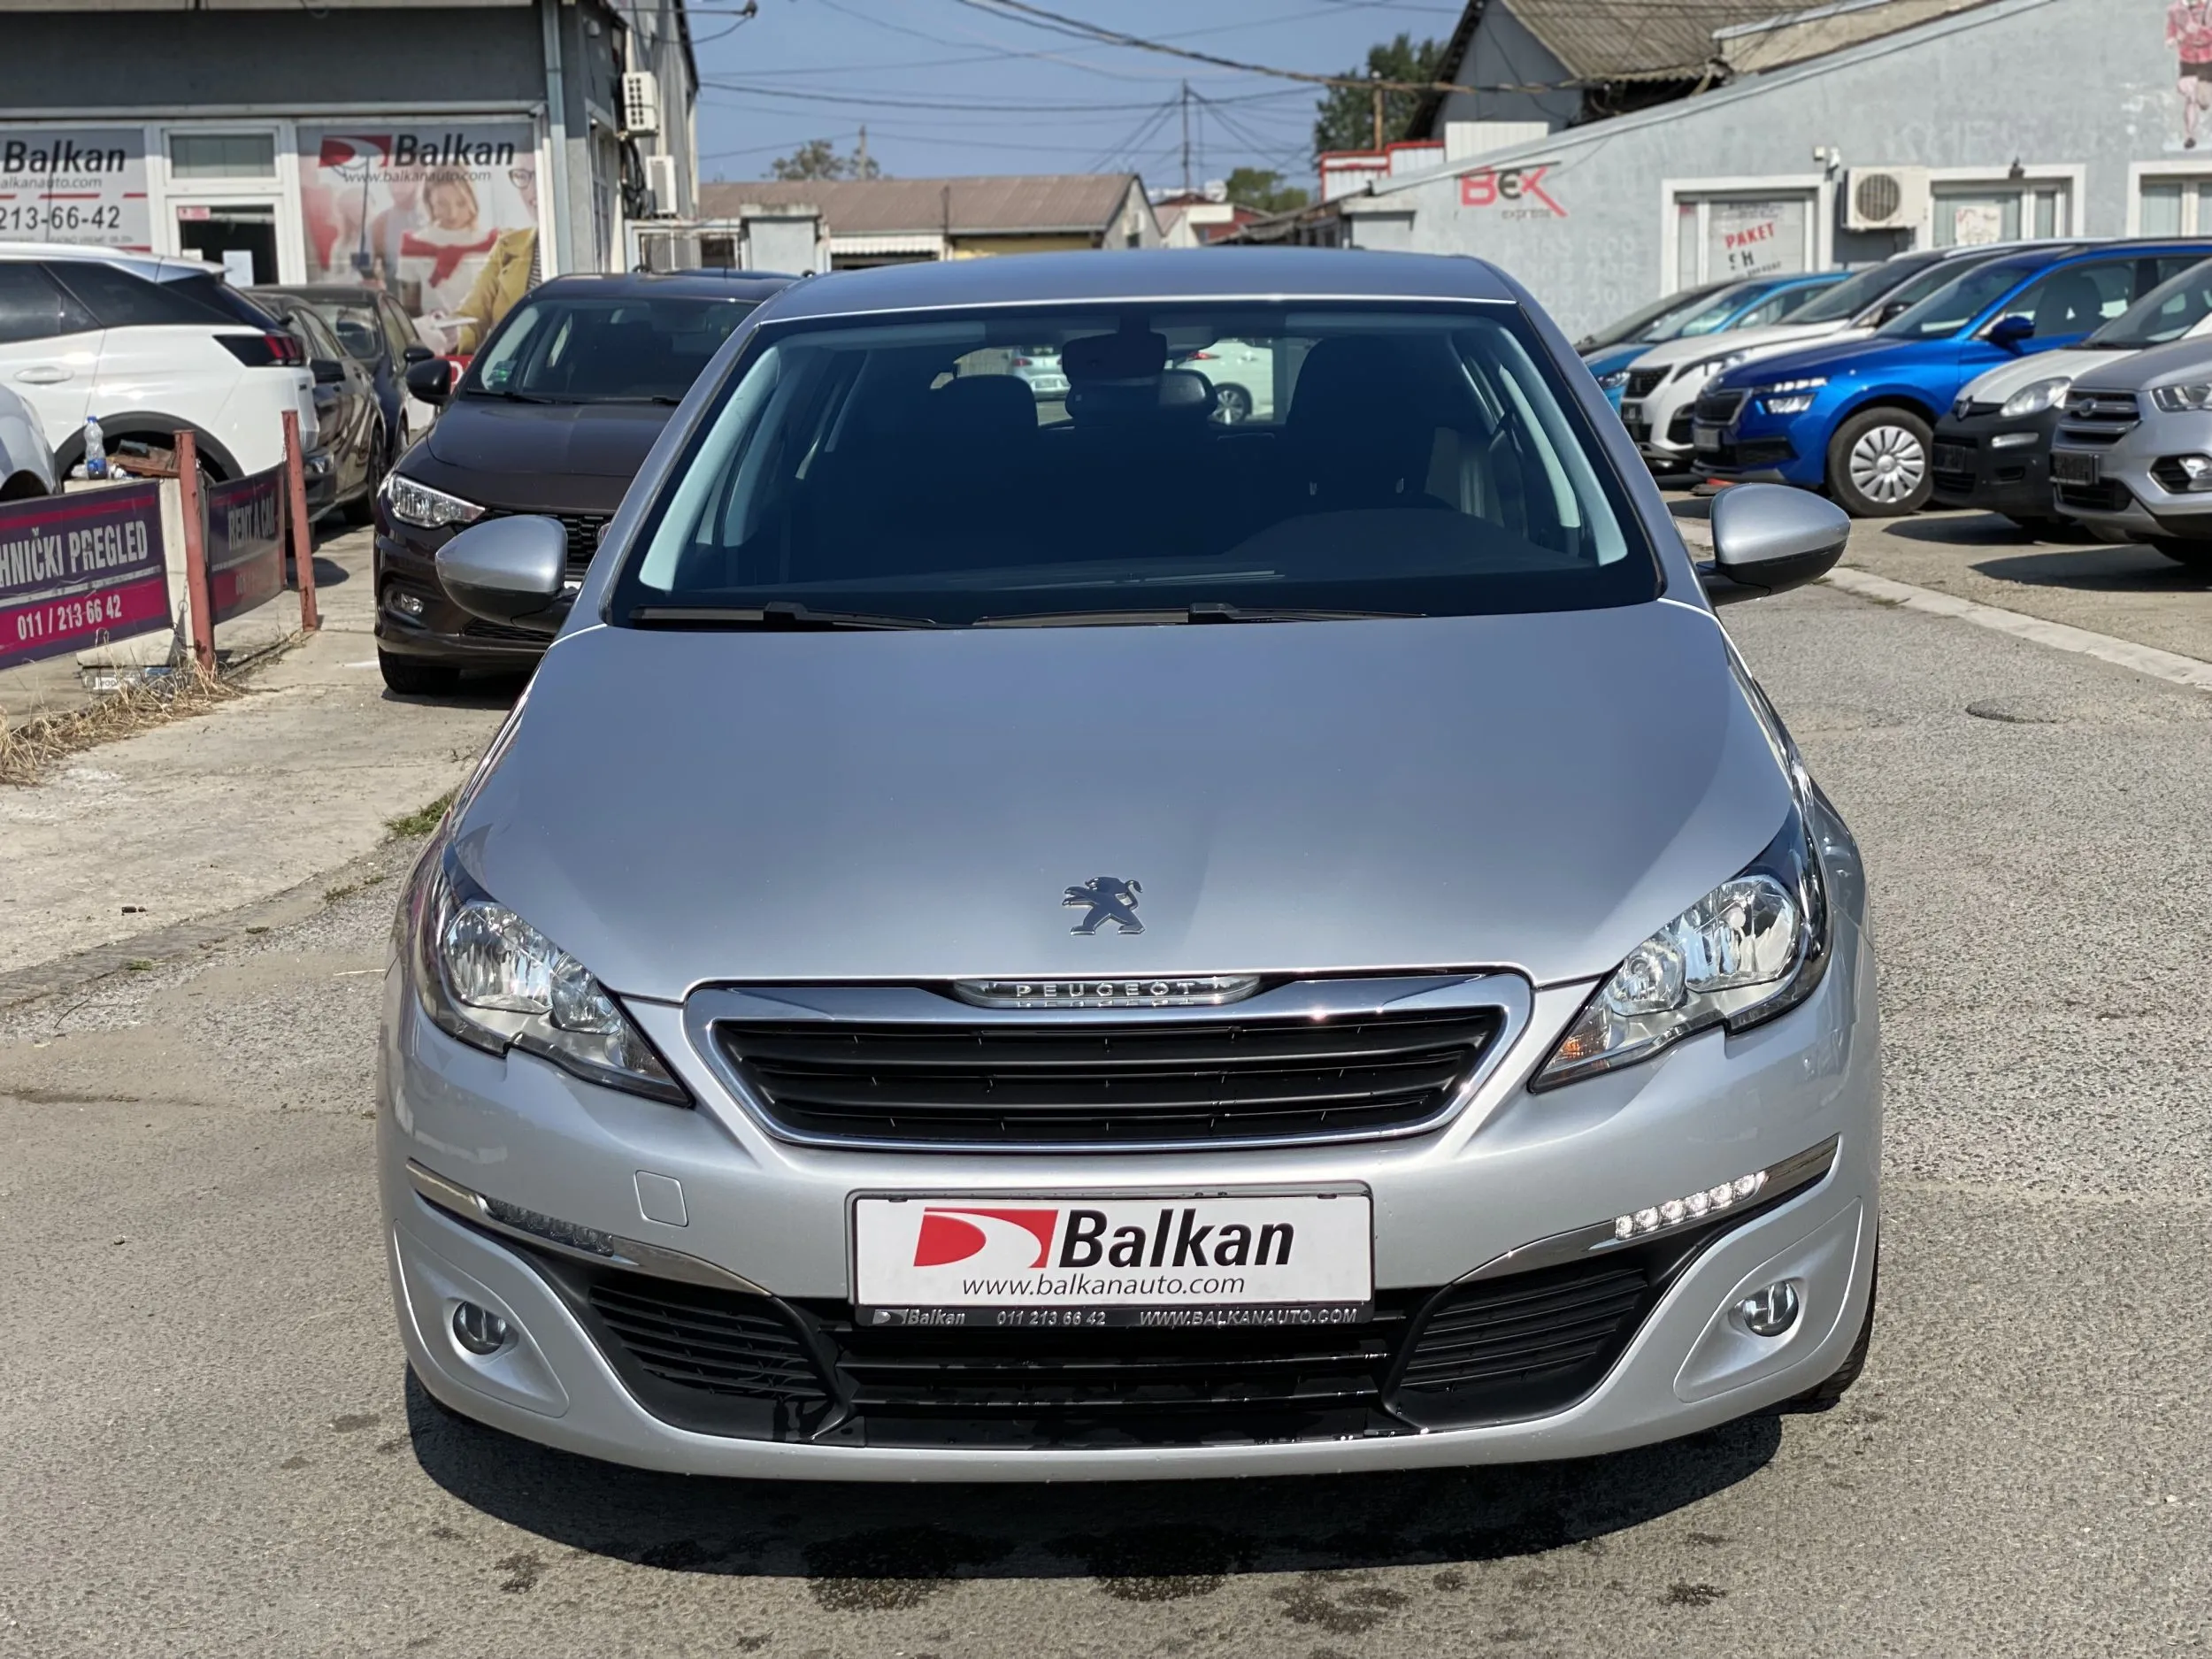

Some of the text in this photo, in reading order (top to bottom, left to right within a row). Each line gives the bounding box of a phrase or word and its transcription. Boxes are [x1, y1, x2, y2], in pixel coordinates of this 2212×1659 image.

[4, 140, 126, 173] Balkan
[395, 134, 515, 166] Balkan
[344, 168, 491, 185] www.balkanauto.com
[1725, 220, 1776, 250] PAKET
[227, 503, 253, 551] RENT
[254, 501, 261, 540] A
[68, 519, 149, 573] PREGLED
[18, 611, 43, 641] 011
[58, 602, 83, 632] 213
[86, 598, 103, 625] 66
[106, 594, 122, 619] 42
[1017, 981, 1195, 998] PEUGEOT
[1058, 1207, 1295, 1269] Balkan
[963, 1272, 1246, 1296] www.balkanauto.com
[907, 1308, 1358, 1325] Balkan 011 213 66 42 WWW.BALKANAUTO.COM
